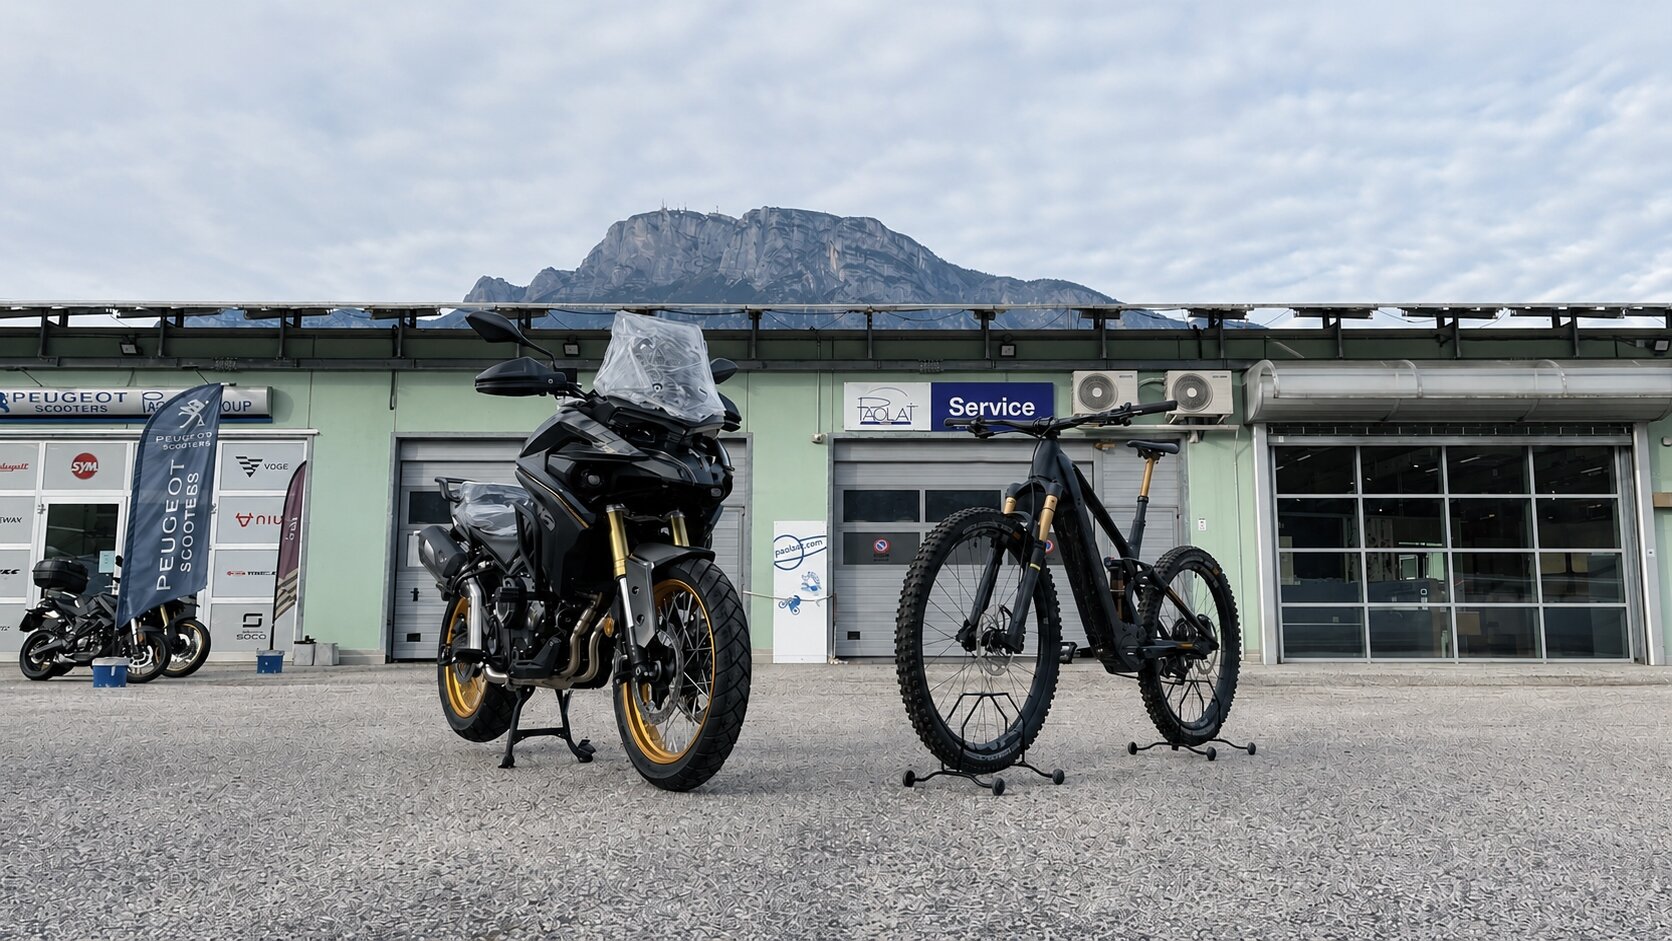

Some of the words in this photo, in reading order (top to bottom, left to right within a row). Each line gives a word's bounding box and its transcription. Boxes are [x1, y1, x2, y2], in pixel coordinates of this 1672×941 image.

[12, 392, 128, 403] PEUGEOT
[35, 405, 109, 413] SCOOTERS
[221, 400, 252, 413] OUP
[949, 396, 1036, 417] Service
[71, 461, 99, 474] SYM
[264, 463, 289, 471] VOGE
[156, 459, 185, 591] PEUGEOT
[236, 633, 267, 641] SOCO
